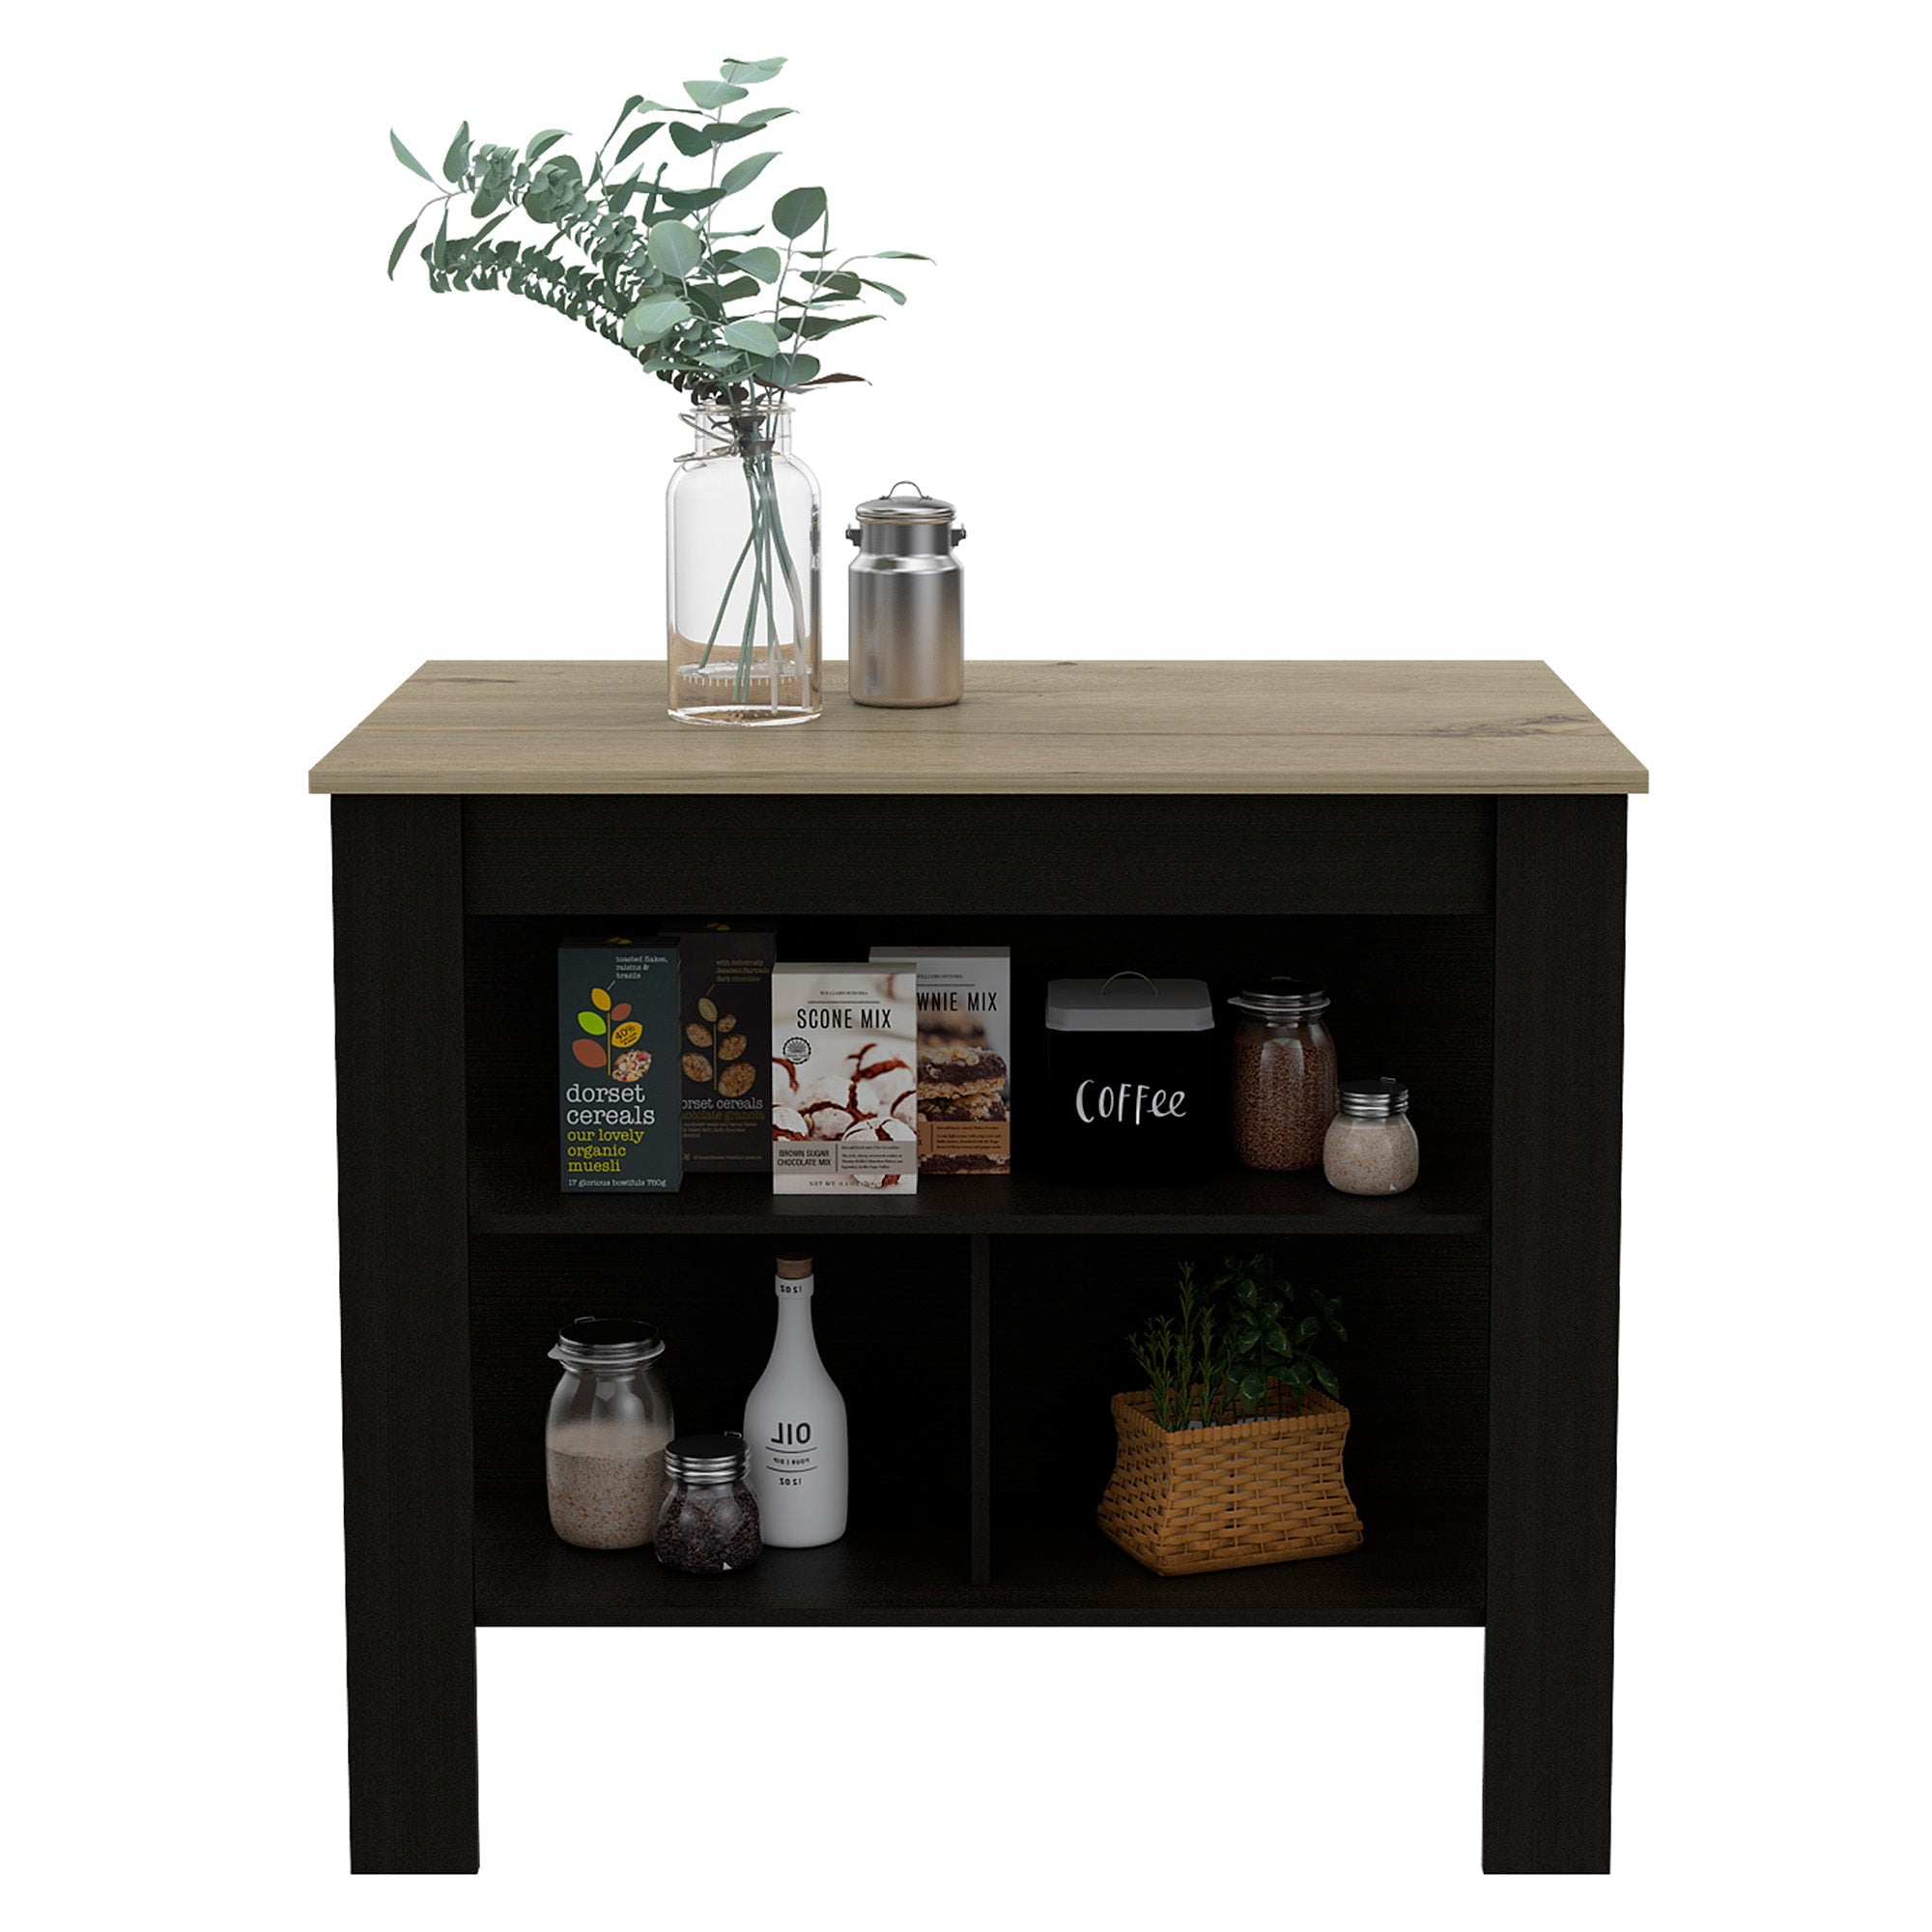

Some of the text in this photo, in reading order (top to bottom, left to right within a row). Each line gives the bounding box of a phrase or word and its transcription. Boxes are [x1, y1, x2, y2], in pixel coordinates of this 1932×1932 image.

[968, 992, 997, 1011] MIX
[797, 1008, 892, 1029] SCONE MIX
[566, 1083, 645, 1103] dorset
[716, 1096, 763, 1110] cereals
[566, 1105, 656, 1125] cereals
[567, 1128, 645, 1144] our lovely
[567, 1144, 627, 1159] organic
[779, 1149, 830, 1157] BROWN SUGAR
[567, 1158, 621, 1172] muesli
